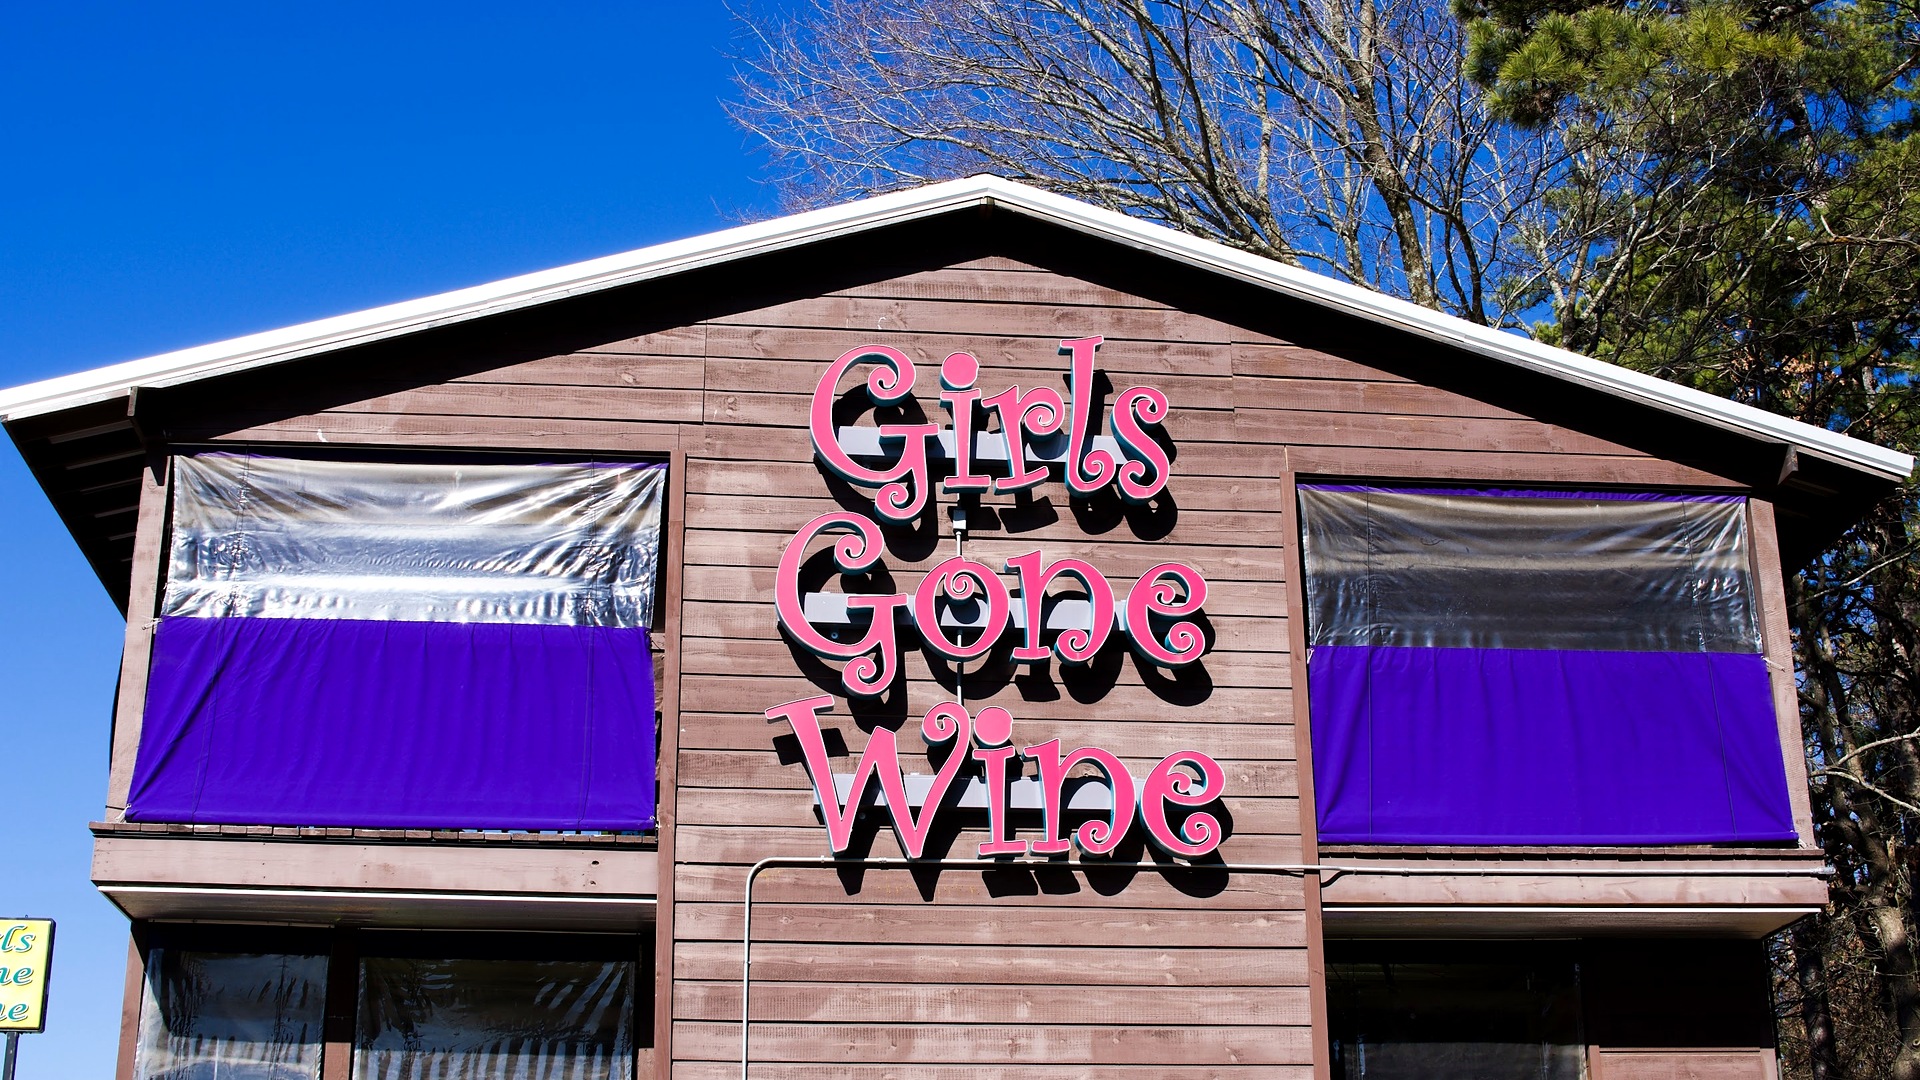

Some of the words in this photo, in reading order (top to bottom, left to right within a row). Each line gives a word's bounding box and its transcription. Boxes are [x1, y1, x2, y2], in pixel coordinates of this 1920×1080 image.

[809, 335, 1170, 524] Girls
[775, 511, 1208, 696] Gone
[764, 694, 1227, 861] Wine
[0, 925, 35, 952] ls
